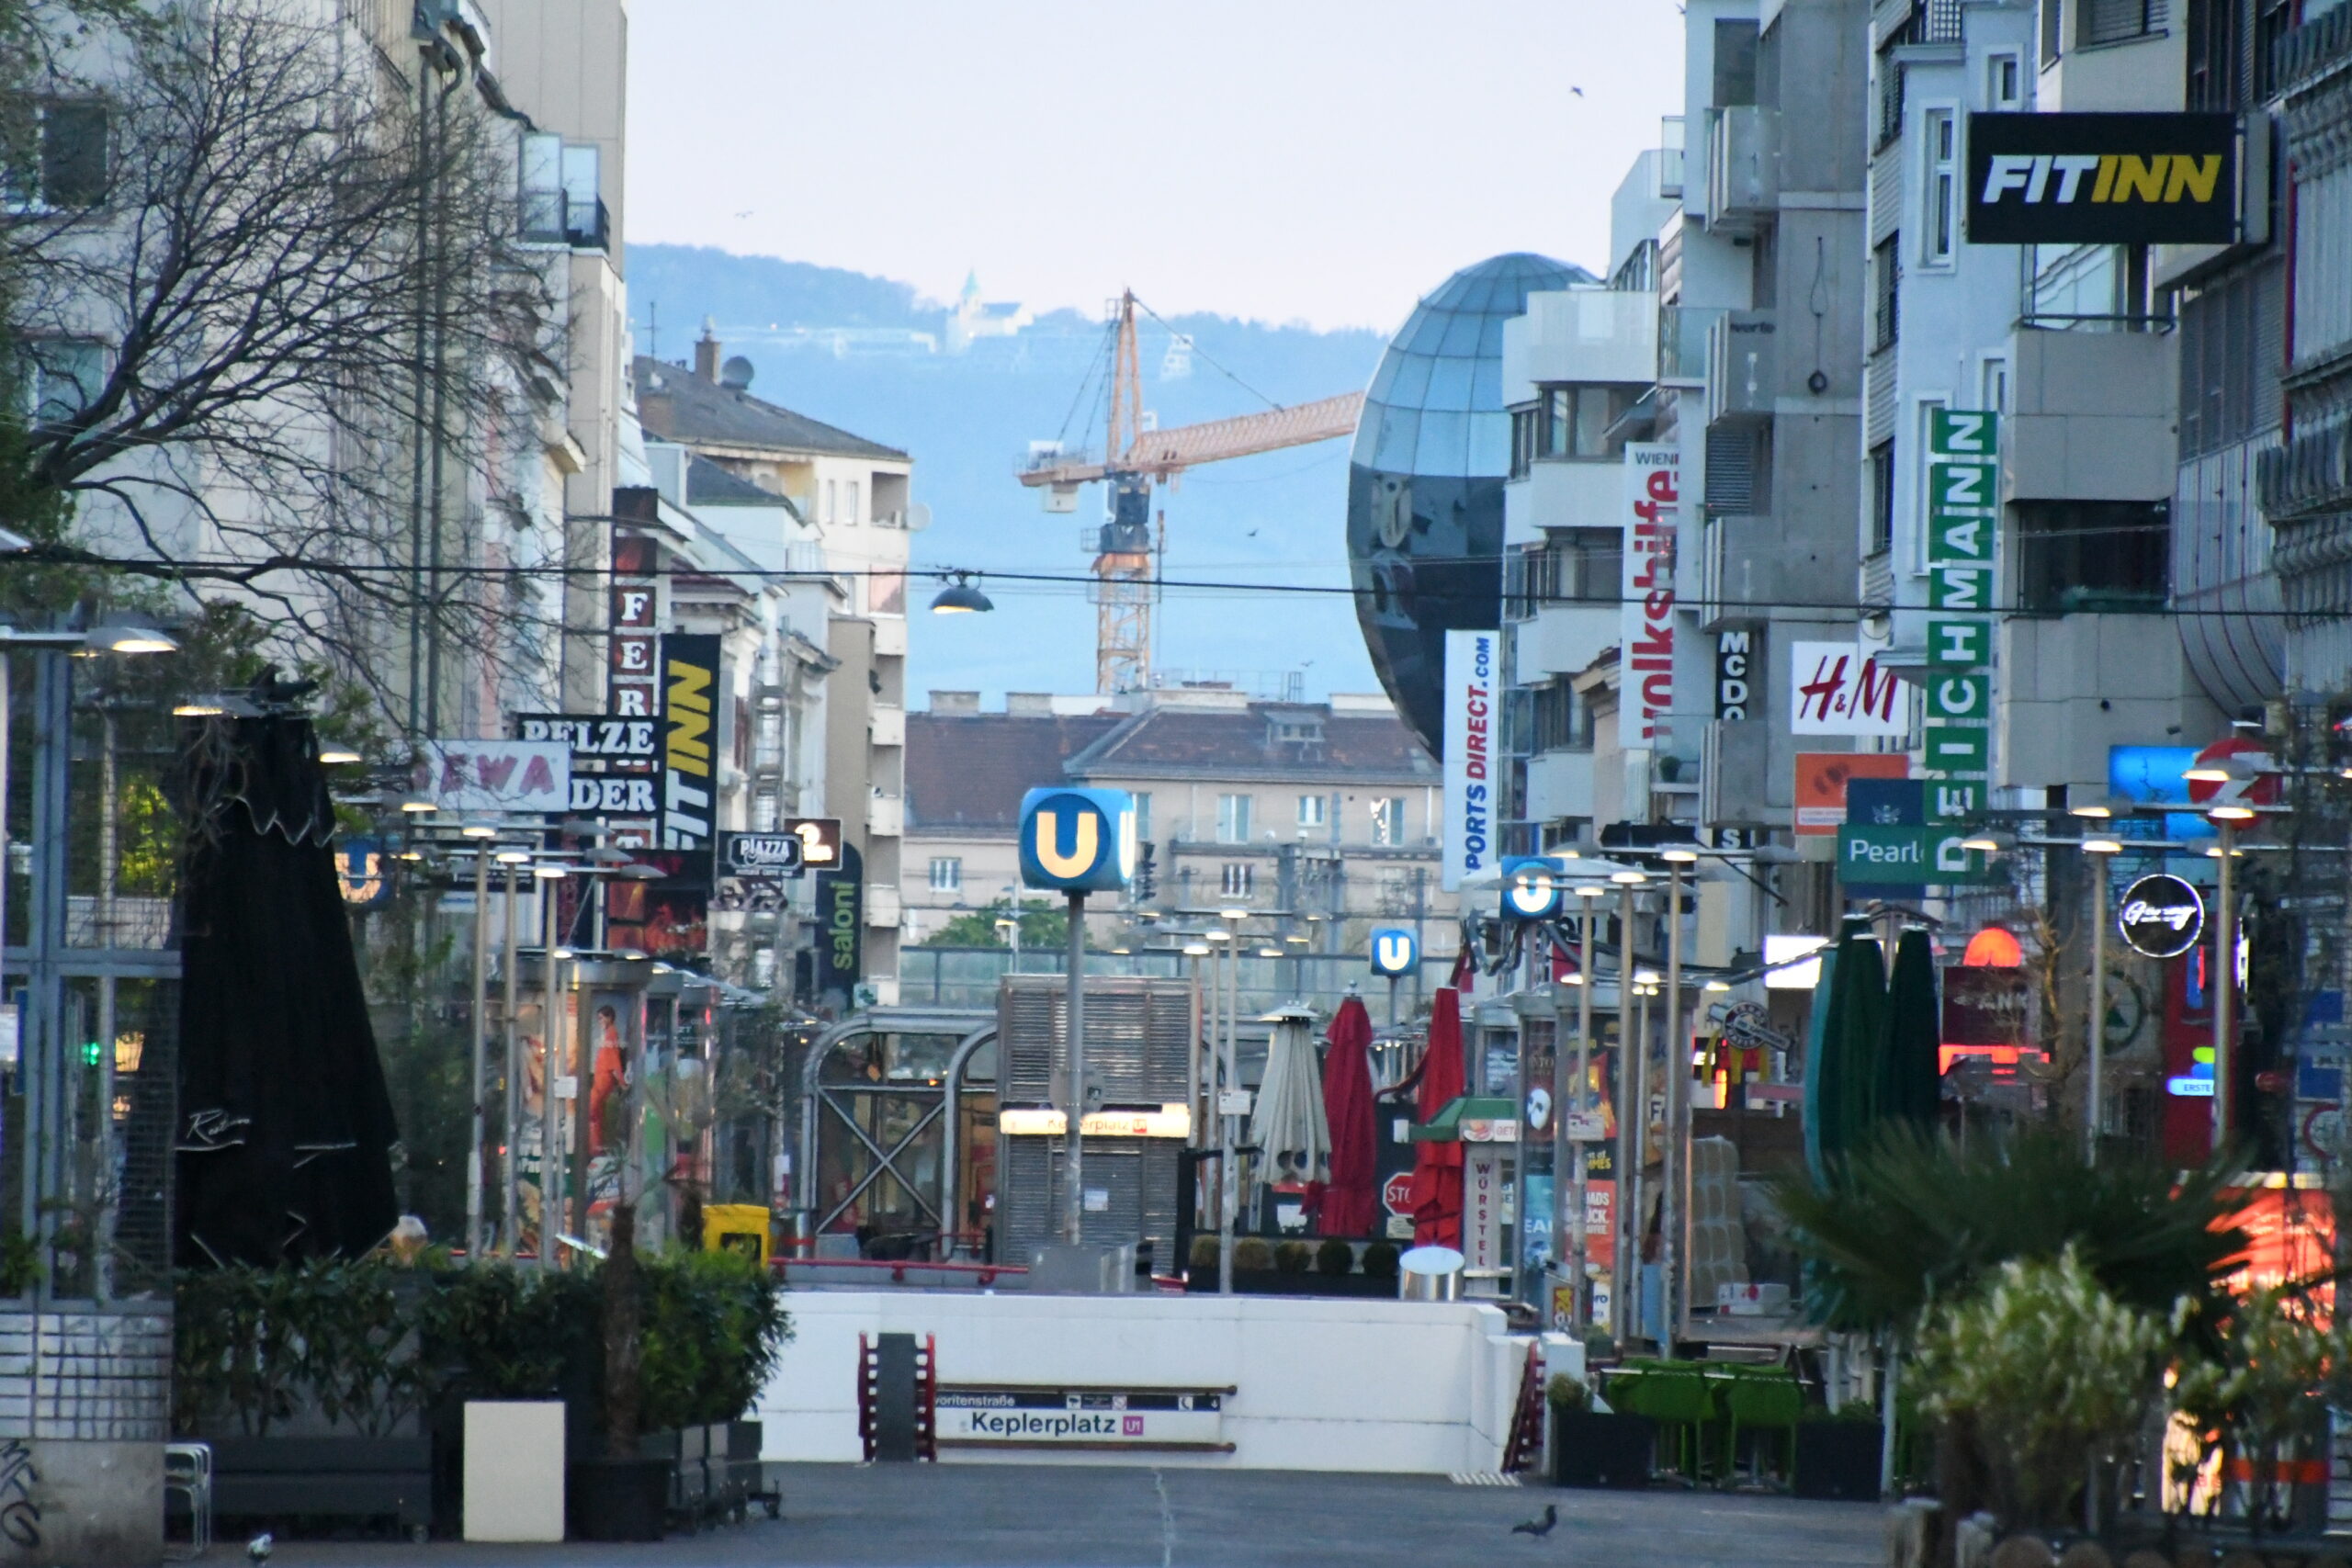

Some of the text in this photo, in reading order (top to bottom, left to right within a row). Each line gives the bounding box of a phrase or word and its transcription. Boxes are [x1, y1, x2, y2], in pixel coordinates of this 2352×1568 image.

[1983, 154, 2222, 203] FITINN
[1938, 413, 1984, 873] DEICHMANN
[1800, 655, 1898, 723] H&M
[1464, 637, 1490, 874] PORTSDIRECT.COM
[571, 779, 656, 811] DER
[1036, 812, 1098, 879] U
[1850, 840, 1924, 863] Pearl
[334, 852, 381, 903] U
[1512, 875, 1552, 913] U
[1379, 937, 1409, 970] U
[2183, 1083, 2211, 1093] ERSTE
[1476, 1163, 1491, 1267] WÜRSTEL
[971, 1412, 1141, 1437] Keplerplatz U1
